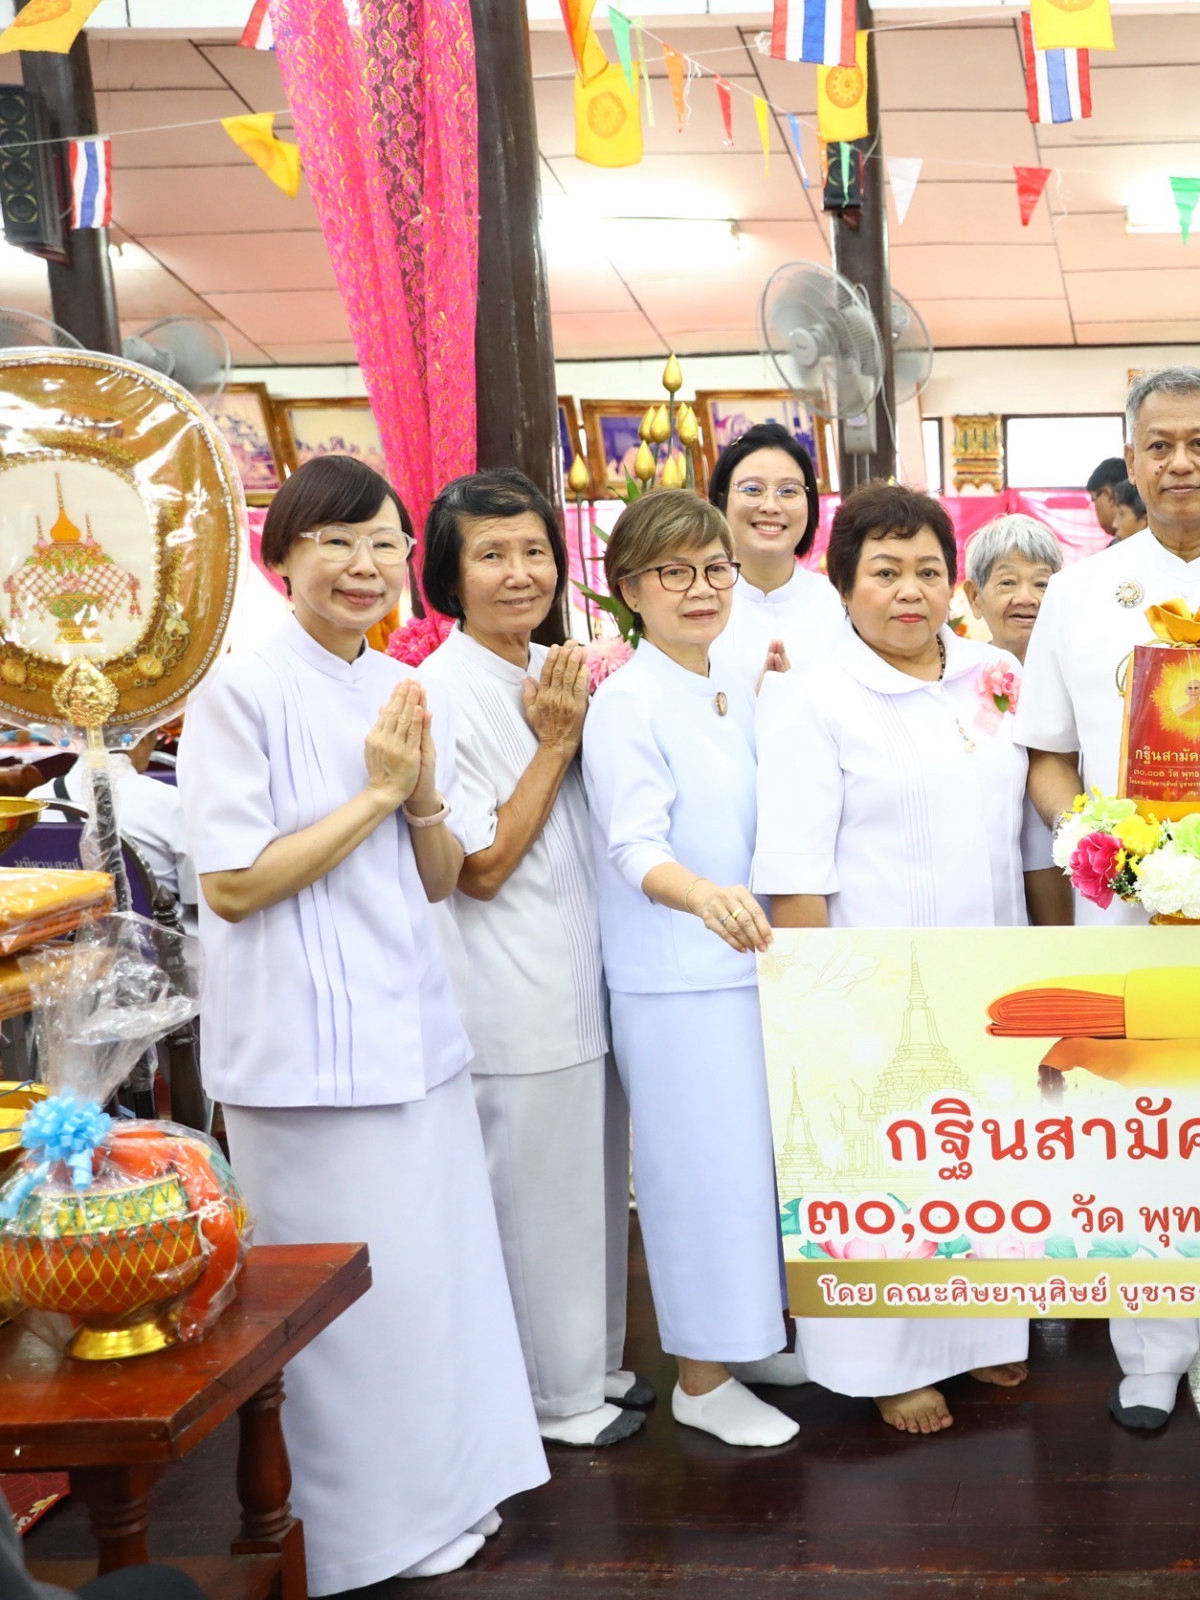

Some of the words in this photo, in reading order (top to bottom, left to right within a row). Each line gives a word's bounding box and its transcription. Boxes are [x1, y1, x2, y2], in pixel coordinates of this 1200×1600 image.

[807, 1199, 1052, 1244] ๓๐,๐๐๐
[1071, 1193, 1124, 1233] วัด
[820, 1276, 873, 1302] โดย
[886, 1276, 1107, 1311] คณะศิษยานุศิษย์
